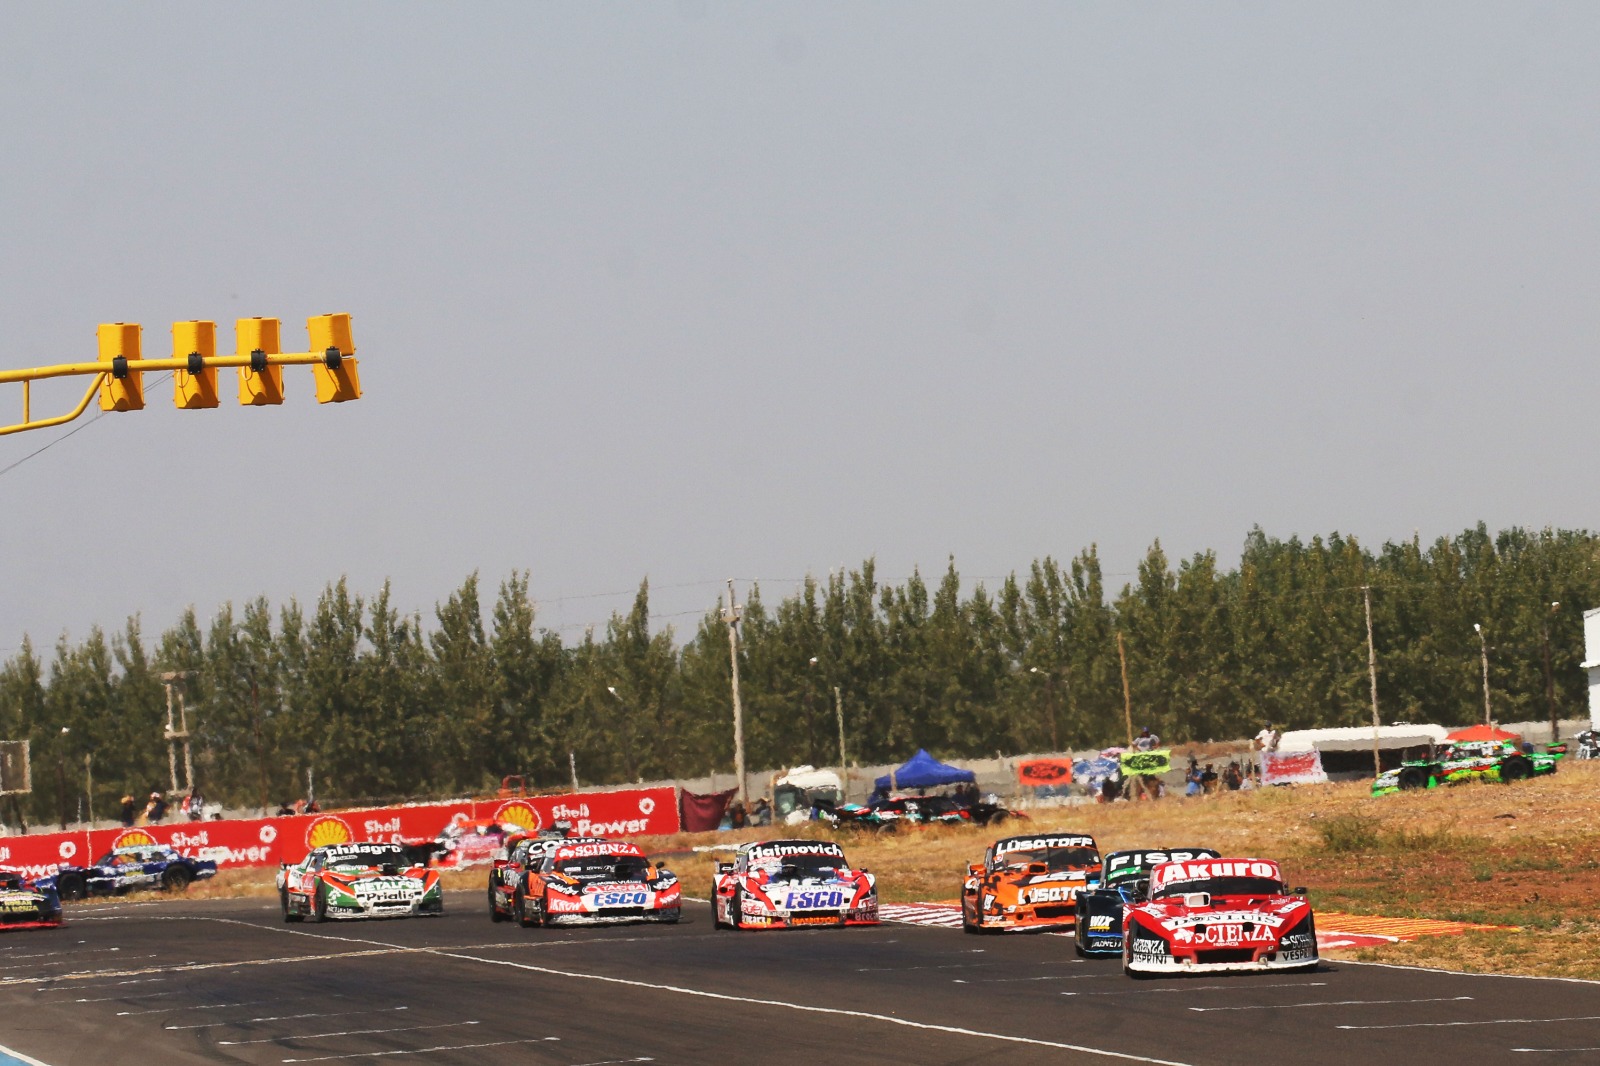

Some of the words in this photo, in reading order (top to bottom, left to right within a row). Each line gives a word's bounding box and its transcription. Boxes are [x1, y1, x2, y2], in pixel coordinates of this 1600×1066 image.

[552, 803, 590, 819] Shell
[364, 817, 400, 833] Shell
[170, 830, 208, 847] Shell
[327, 843, 402, 858] philagro
[575, 843, 640, 857] SCIENZA
[750, 844, 844, 859] Haimovich
[593, 892, 647, 907] ESCO
[785, 891, 843, 909] ESCO
[1194, 924, 1275, 943] SCIENZA
